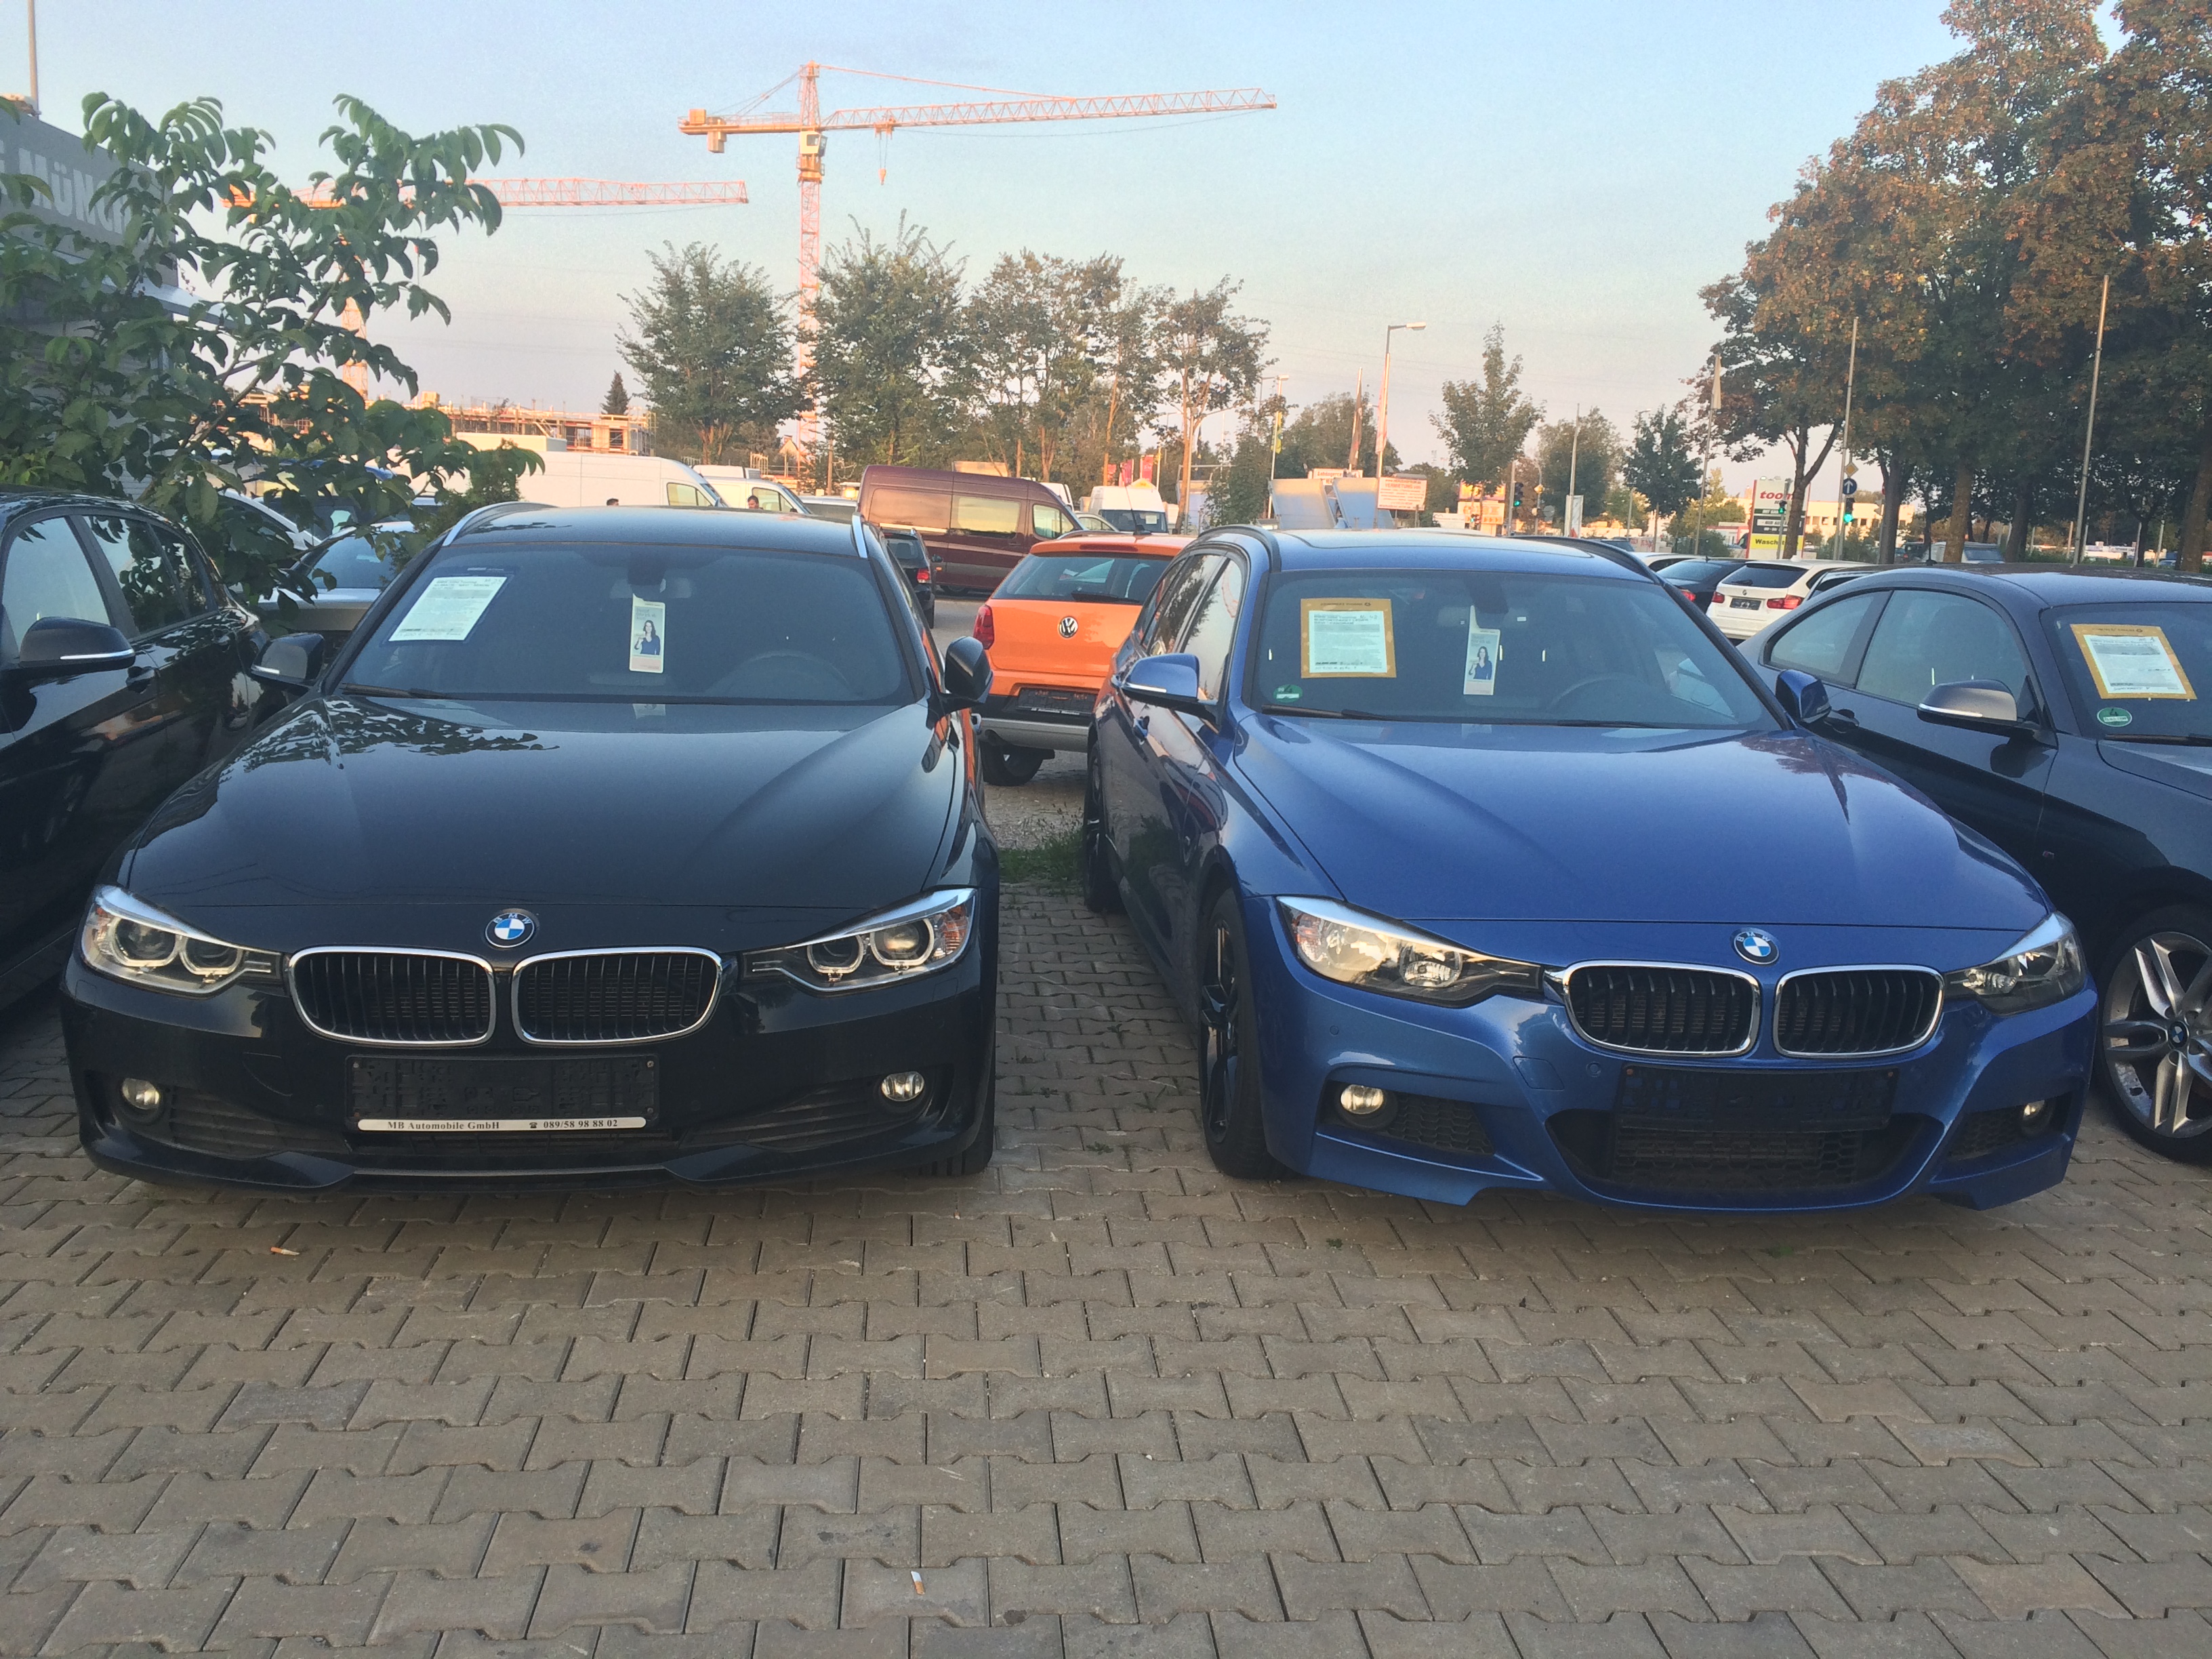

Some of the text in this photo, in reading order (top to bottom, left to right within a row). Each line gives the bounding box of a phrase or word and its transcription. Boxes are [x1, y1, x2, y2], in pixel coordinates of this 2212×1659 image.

[493, 913, 532, 924] BMW
[1736, 931, 1770, 942] BMW
[468, 1122, 499, 1130] GmbH
[578, 1120, 590, 1128] 98
